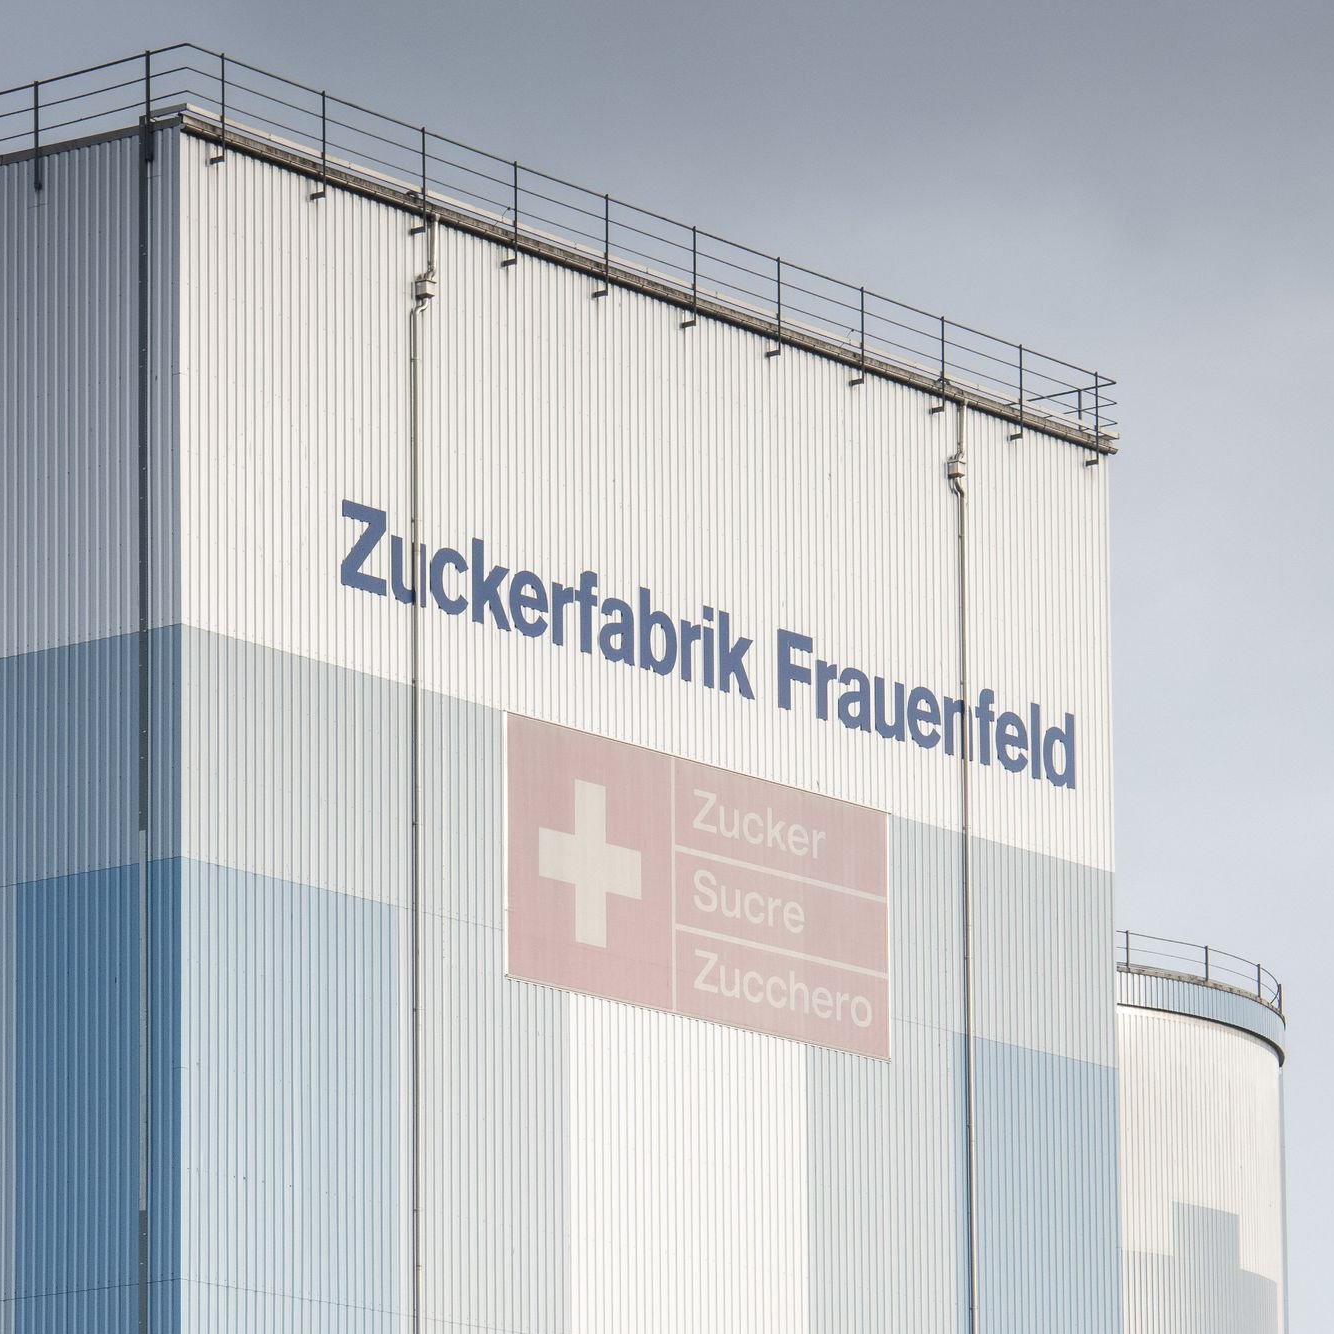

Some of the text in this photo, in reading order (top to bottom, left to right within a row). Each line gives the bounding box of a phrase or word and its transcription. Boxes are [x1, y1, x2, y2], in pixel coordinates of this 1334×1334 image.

[341, 499, 1075, 789] Zuckerfabrik Frauenfeld
[692, 789, 826, 858] Zucker
[693, 869, 805, 933] Sucre
[693, 949, 873, 1028] Zucchero
